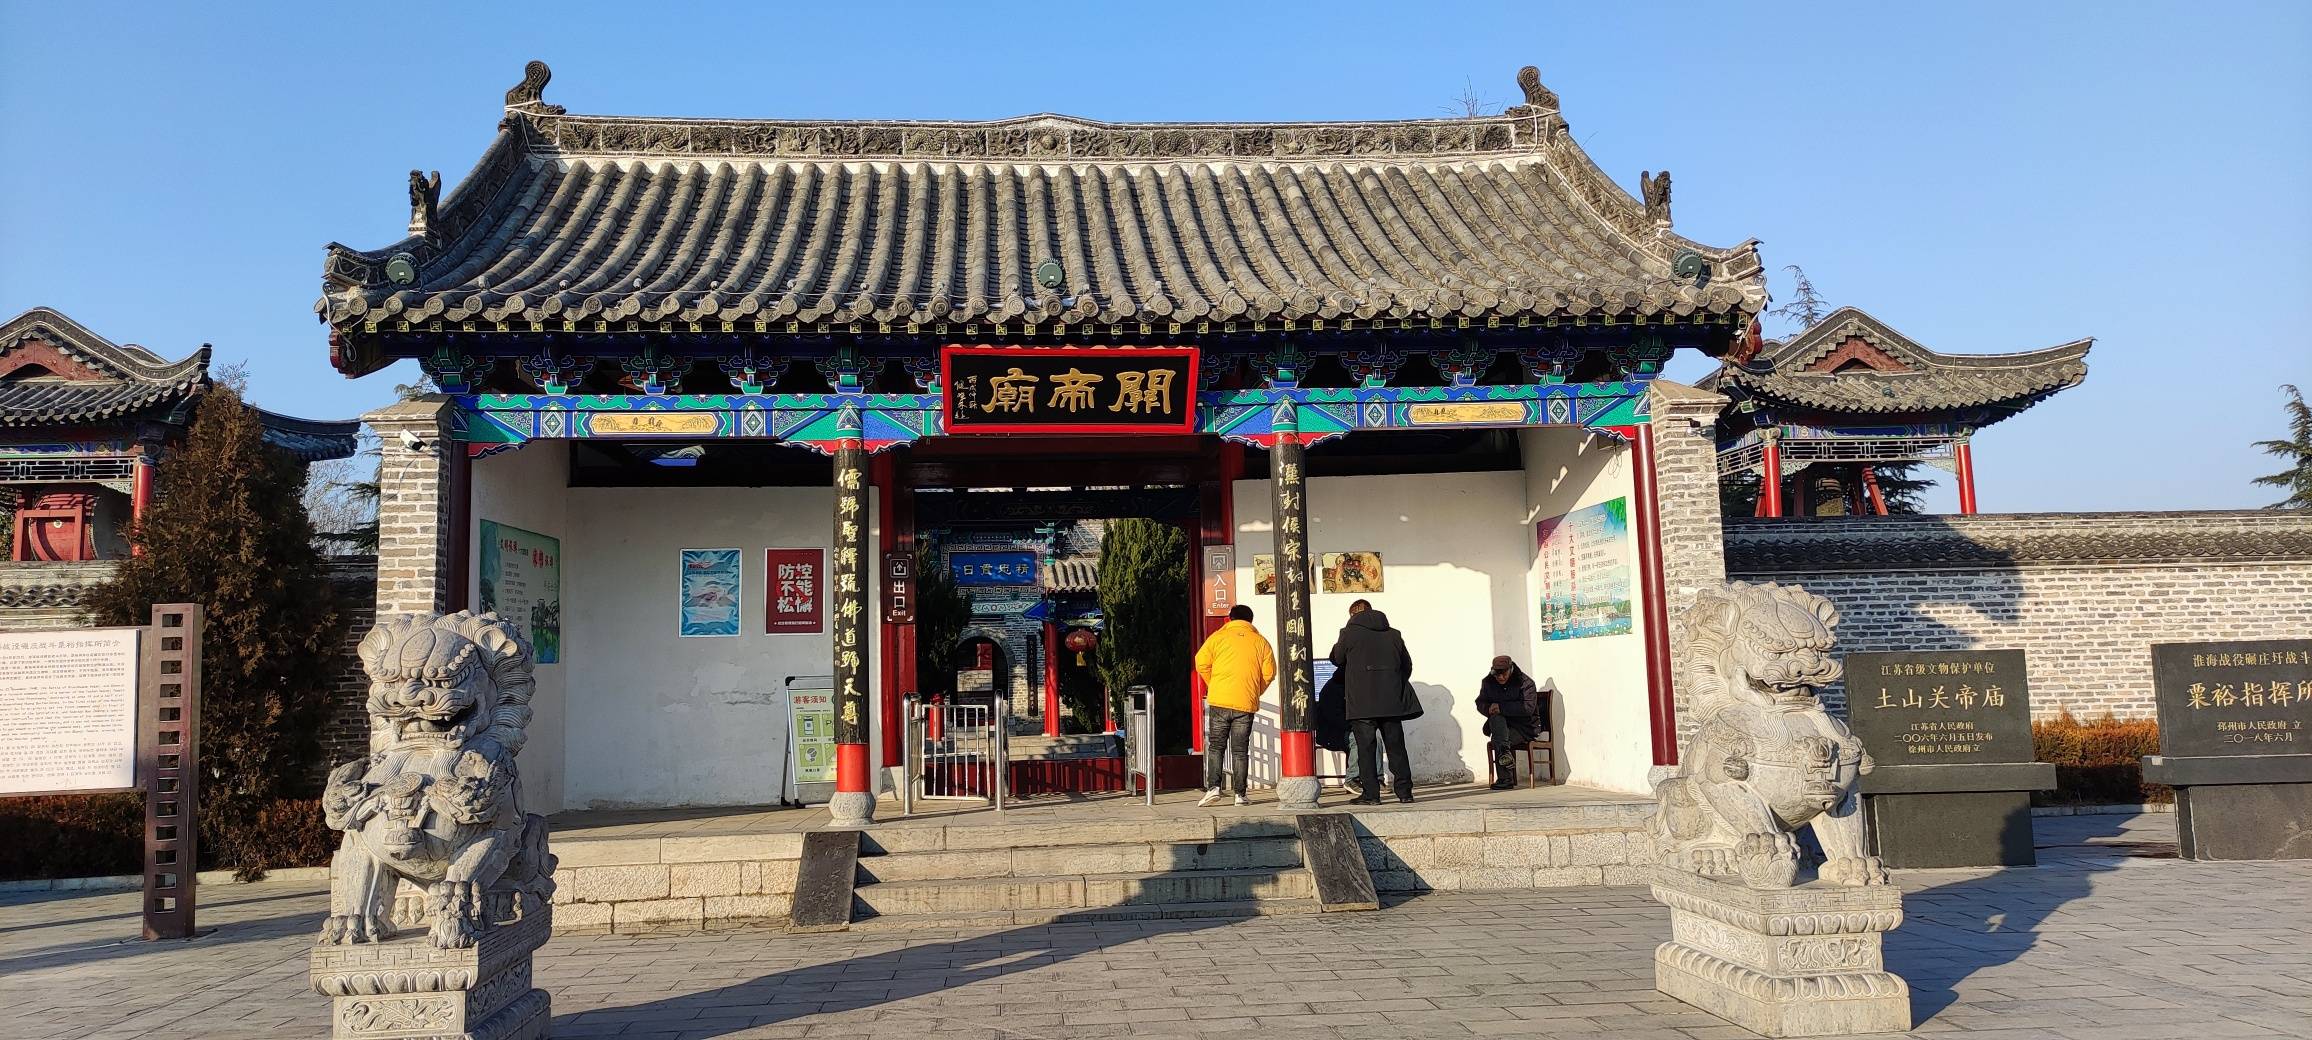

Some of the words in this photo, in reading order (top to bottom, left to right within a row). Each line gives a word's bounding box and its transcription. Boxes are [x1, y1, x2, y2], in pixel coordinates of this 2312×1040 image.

[777, 563, 813, 580] 防控
[780, 580, 813, 597] 不能
[893, 580, 905, 608] 出口
[1213, 574, 1226, 601] 入口
[777, 597, 813, 614] 松懈
[1880, 661, 1996, 676] 江苏省级文物保护单位
[1873, 684, 2004, 711] 土山关帝庙
[1910, 721, 1974, 731] 江苏省人民政府
